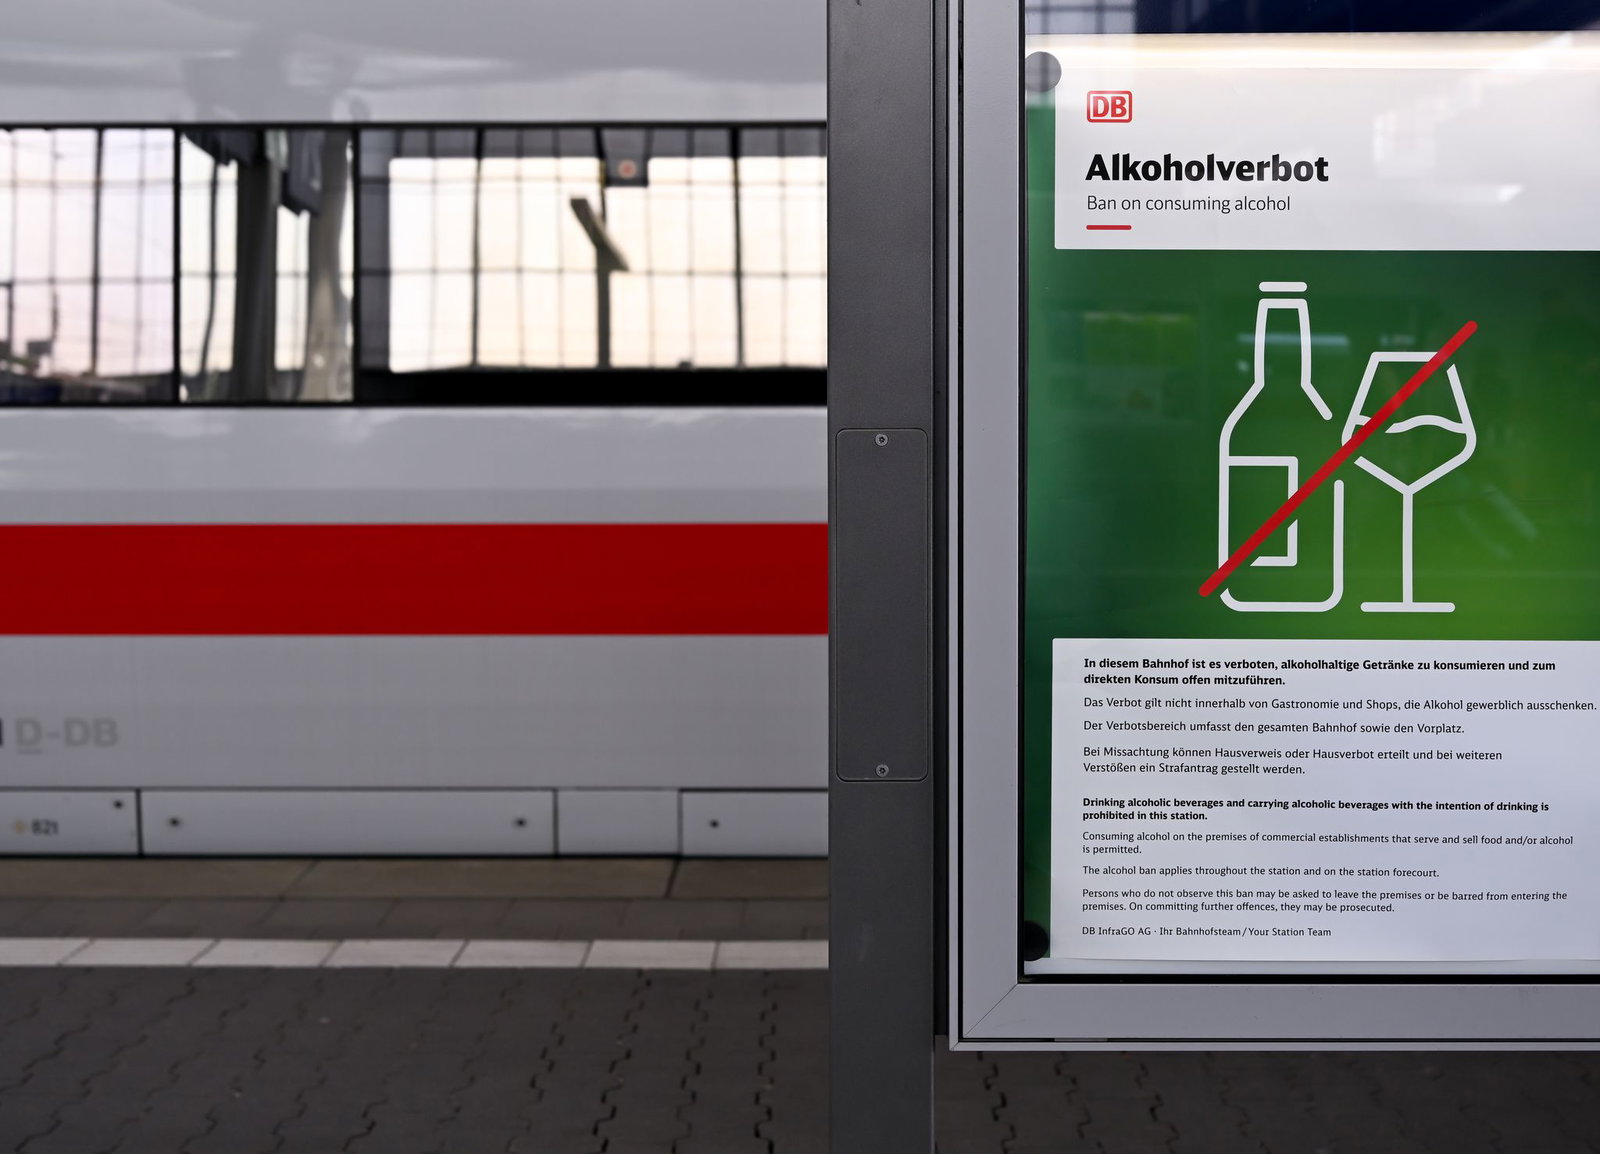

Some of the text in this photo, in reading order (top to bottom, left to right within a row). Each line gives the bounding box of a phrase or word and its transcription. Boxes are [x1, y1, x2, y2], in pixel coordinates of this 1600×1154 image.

[1092, 96, 1127, 118] DB
[1084, 152, 1329, 182] Alkoholverbot
[1087, 195, 1290, 215] Ban on consuming alcohol
[1084, 657, 1556, 672] In diesem Bahnhof ist es verboten, alkoholhaltige Getränke zu konsumieren und zum
[1083, 673, 1286, 686] direkten Konsum offen mitzuführen.
[1084, 697, 1597, 712] Das Verbot gilt nicht innerhalb von Gastronomie und Shops, die Alkohol gewerblich ausschenken.
[1083, 720, 1465, 735] Der Verbotsbereich umfasst den gesamten Bahnhof sowie den Vorplatz.
[16, 718, 119, 754] D-DB
[1083, 746, 1502, 760] Bei Missachtung können Hausverweis oder Hausverbot erteilt und bei weiteren
[1082, 762, 1306, 776] Verstößen ein Strafantrag gestellt werden.
[1082, 797, 1550, 814] Drinking alcoholic beverages and carrying alcoholic beverages with the intention of drinking is
[1082, 810, 1208, 822] prohibited in this station.
[1082, 831, 1135, 844] Consuming
[1136, 831, 1170, 842] alcohol
[1187, 832, 1203, 841] the
[1205, 832, 1248, 843] premises
[1249, 831, 1260, 842] of
[1261, 832, 1316, 842] commercial
[1318, 833, 1390, 843] establishments
[1391, 834, 1412, 844] that
[1414, 836, 1440, 844] serve
[1441, 834, 1460, 844] and
[1462, 835, 1478, 844] sell
[1480, 835, 1503, 844] food
[1504, 835, 1538, 846] and/or
[1539, 835, 1574, 844] alcohol
[1082, 844, 1142, 855] is permitted.
[1082, 865, 1440, 877] The alcohol ban applies throughout the station and on the station forecourt.
[1082, 888, 1119, 898] Persons
[1121, 888, 1141, 899] who
[1143, 888, 1156, 898] do
[1158, 890, 1174, 898] not
[1176, 889, 1214, 899] observe
[1216, 889, 1234, 899] this
[1236, 888, 1254, 899] ban
[1256, 891, 1276, 900] may
[1278, 889, 1290, 899] be
[1292, 889, 1320, 899] asked
[1322, 890, 1332, 900] to
[1334, 889, 1359, 899] leave
[1361, 890, 1377, 899] the
[1379, 890, 1422, 903] premises
[1437, 891, 1450, 900] be
[1452, 891, 1484, 901] barred
[1486, 891, 1508, 901] from
[1510, 892, 1550, 902] entering
[1552, 891, 1568, 900] the
[1082, 901, 1395, 913] premises. On committing further offences, they may be prosecuted.
[1082, 926, 1096, 935] DB
[1098, 926, 1136, 936] InfraGO
[1137, 926, 1151, 936] AG
[1159, 926, 1173, 936] Ihr
[1272, 927, 1305, 936] Station
[1307, 927, 1332, 937] Team
